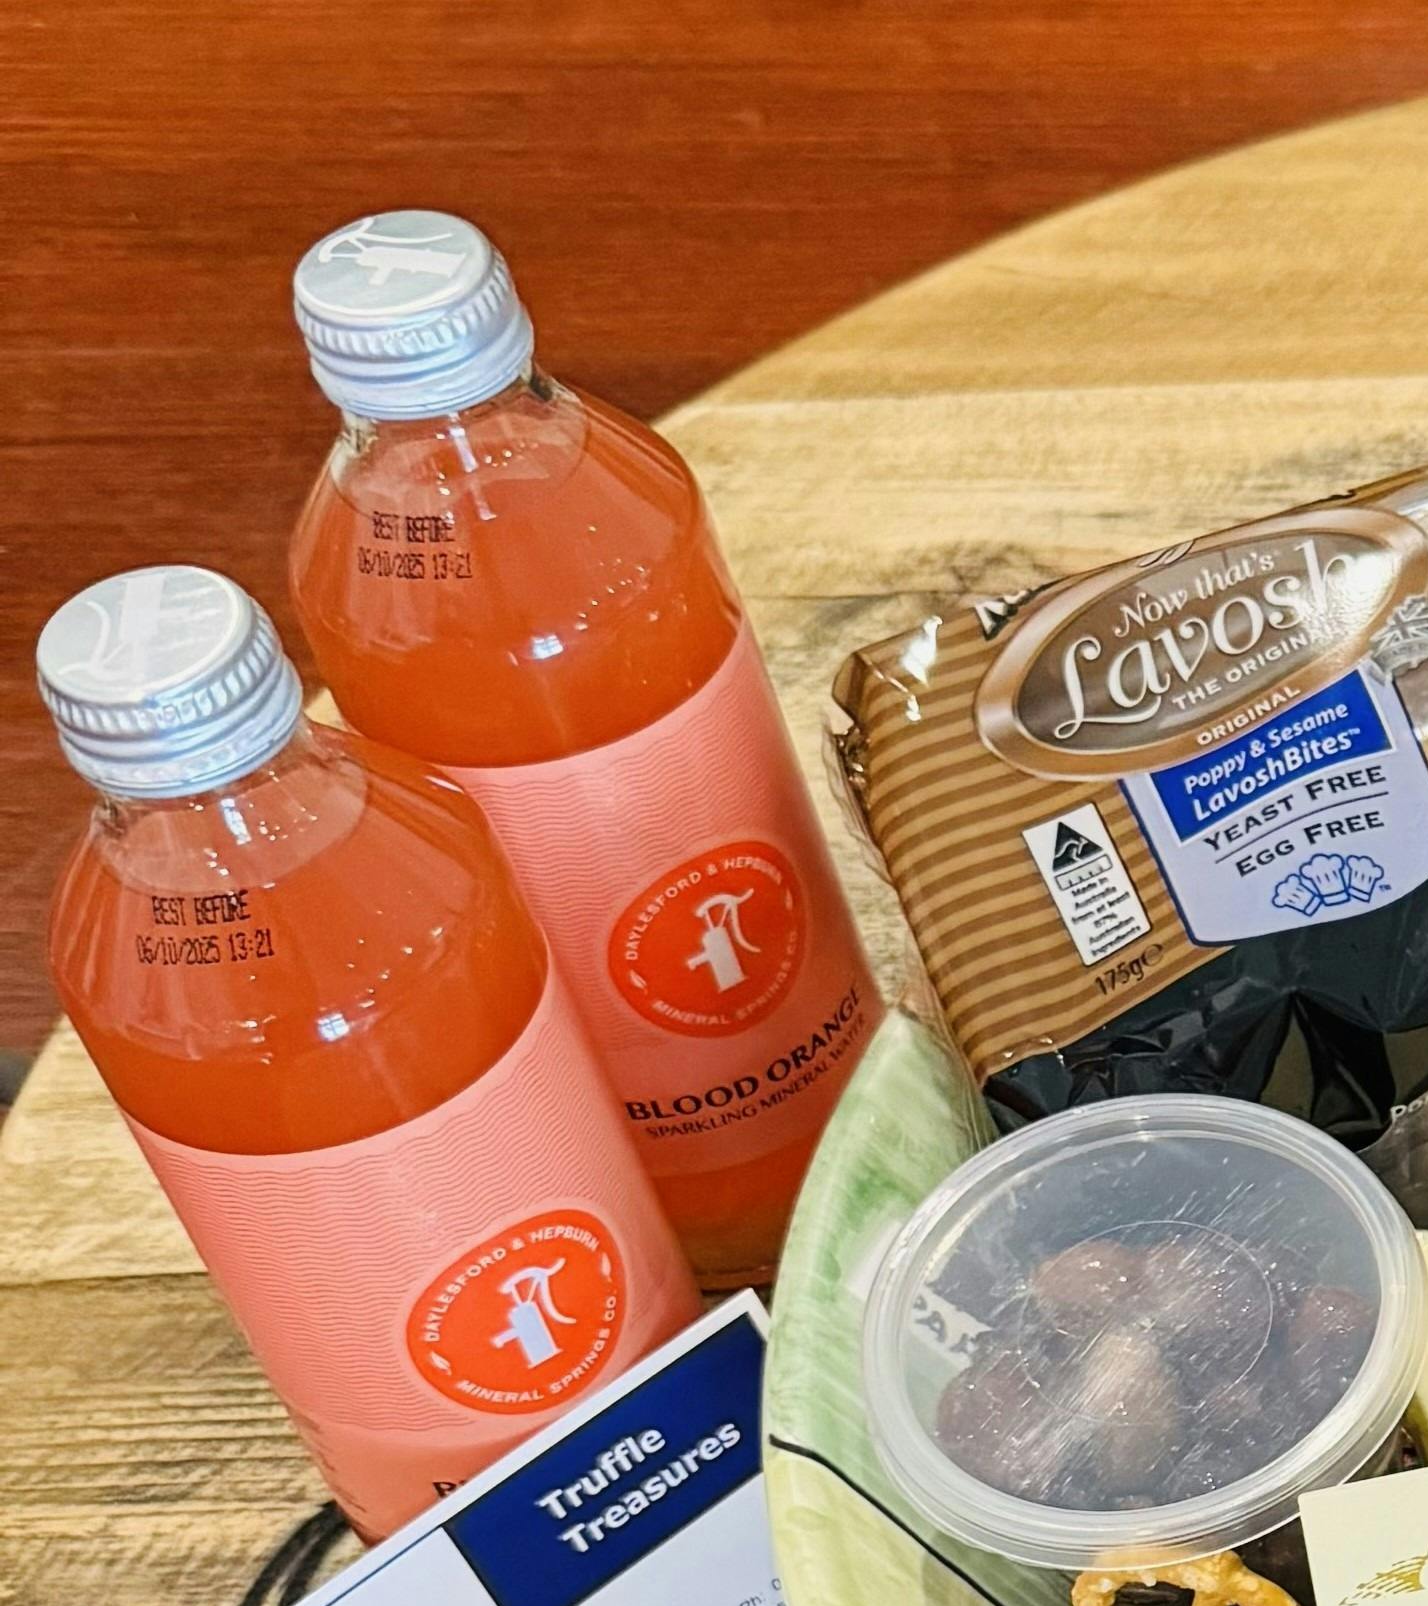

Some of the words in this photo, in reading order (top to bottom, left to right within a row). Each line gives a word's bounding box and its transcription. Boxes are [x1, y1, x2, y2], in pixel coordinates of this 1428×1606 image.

[1113, 591, 1188, 638] Now
[1195, 552, 1274, 600] that's
[1054, 539, 1356, 739] Lavosh
[1171, 677, 1222, 711] THE
[1225, 621, 1345, 684] ORIGINAL
[1184, 749, 1249, 795] Poppy
[1250, 738, 1267, 760] &
[1267, 703, 1349, 749] Sesame
[1196, 684, 1302, 746] ORIGINAL
[1203, 794, 1294, 852] YEAST
[1304, 765, 1388, 803] FREE
[1235, 839, 1296, 879] EGG
[1303, 810, 1386, 845] FREE
[151, 895, 187, 927] BEST
[193, 889, 251, 926] BEFORE
[228, 927, 275, 962] 13:21
[625, 870, 702, 962] DAYLESFORD
[652, 1000, 731, 1026] MINERAL
[625, 1075, 760, 1122] BLOOD
[645, 1105, 758, 1139] SPARKLING
[758, 1060, 830, 1111] MINERAL
[423, 1246, 508, 1343] DAYLESFORD
[511, 1237, 527, 1252] &
[529, 1224, 601, 1253] HEPBURN
[455, 1378, 545, 1405] MINERAL
[549, 1327, 612, 1395] SPRINGS
[534, 1427, 667, 1520] Truffle
[556, 1422, 742, 1543] Treasures
